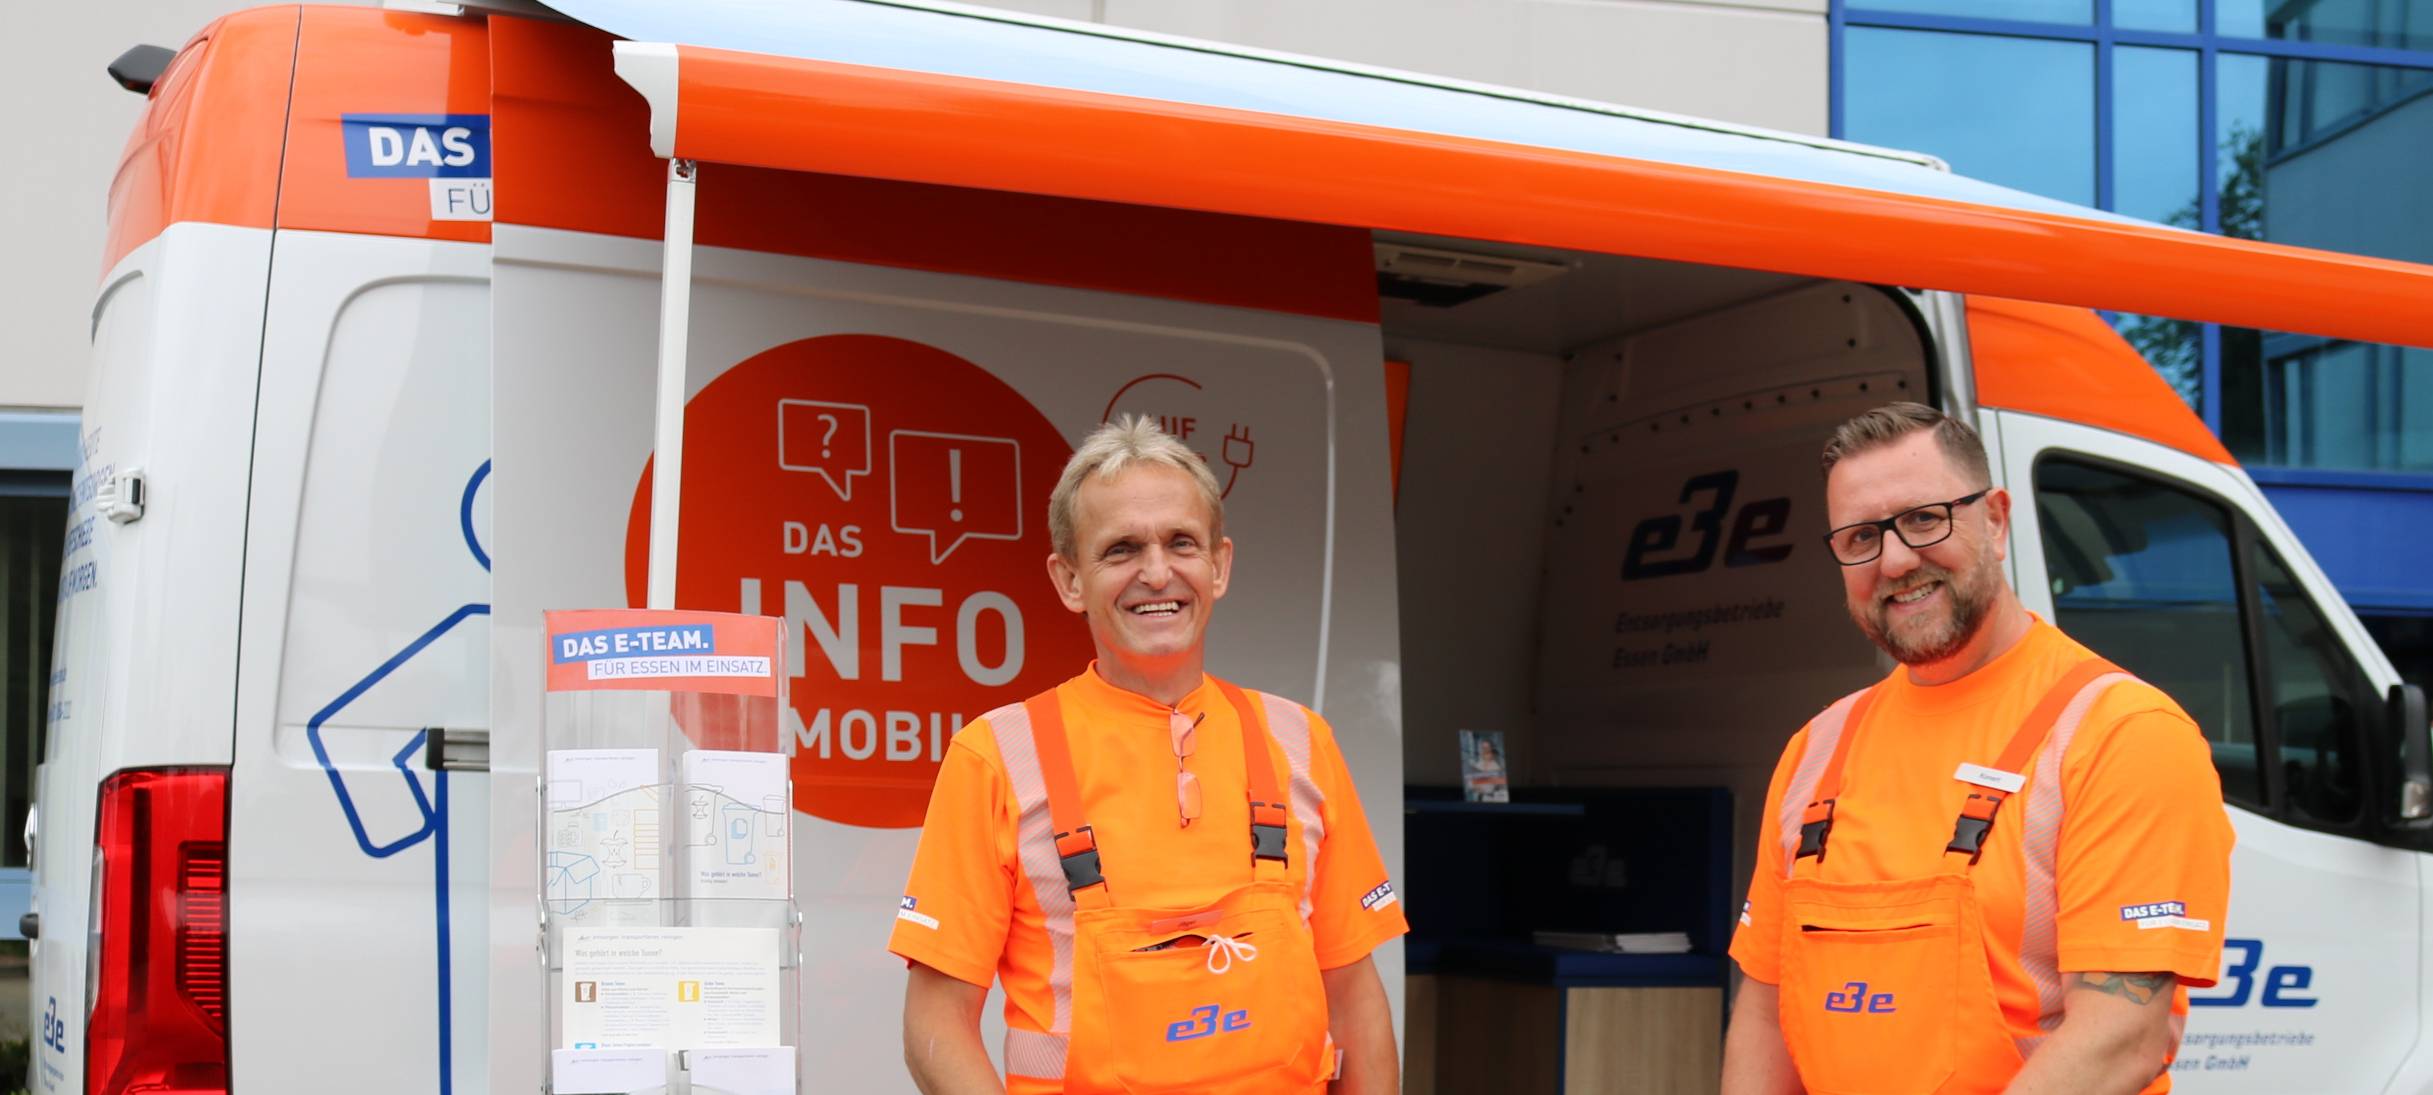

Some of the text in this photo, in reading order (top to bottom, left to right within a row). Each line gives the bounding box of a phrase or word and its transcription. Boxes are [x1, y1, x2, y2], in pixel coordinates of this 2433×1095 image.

[368, 127, 475, 166] DAS
[448, 183, 491, 214] FÜ
[1160, 416, 1196, 440] UF
[783, 521, 863, 558] DAS
[563, 630, 709, 658] DAS E-TEAM.
[594, 660, 768, 676] FÜR ESSEN IM EINSATZ.
[787, 707, 963, 763] MOBI
[2123, 906, 2148, 919] DAS
[2189, 939, 2319, 1007] 3e
[2183, 1031, 2315, 1049] sorgungsbetriebe
